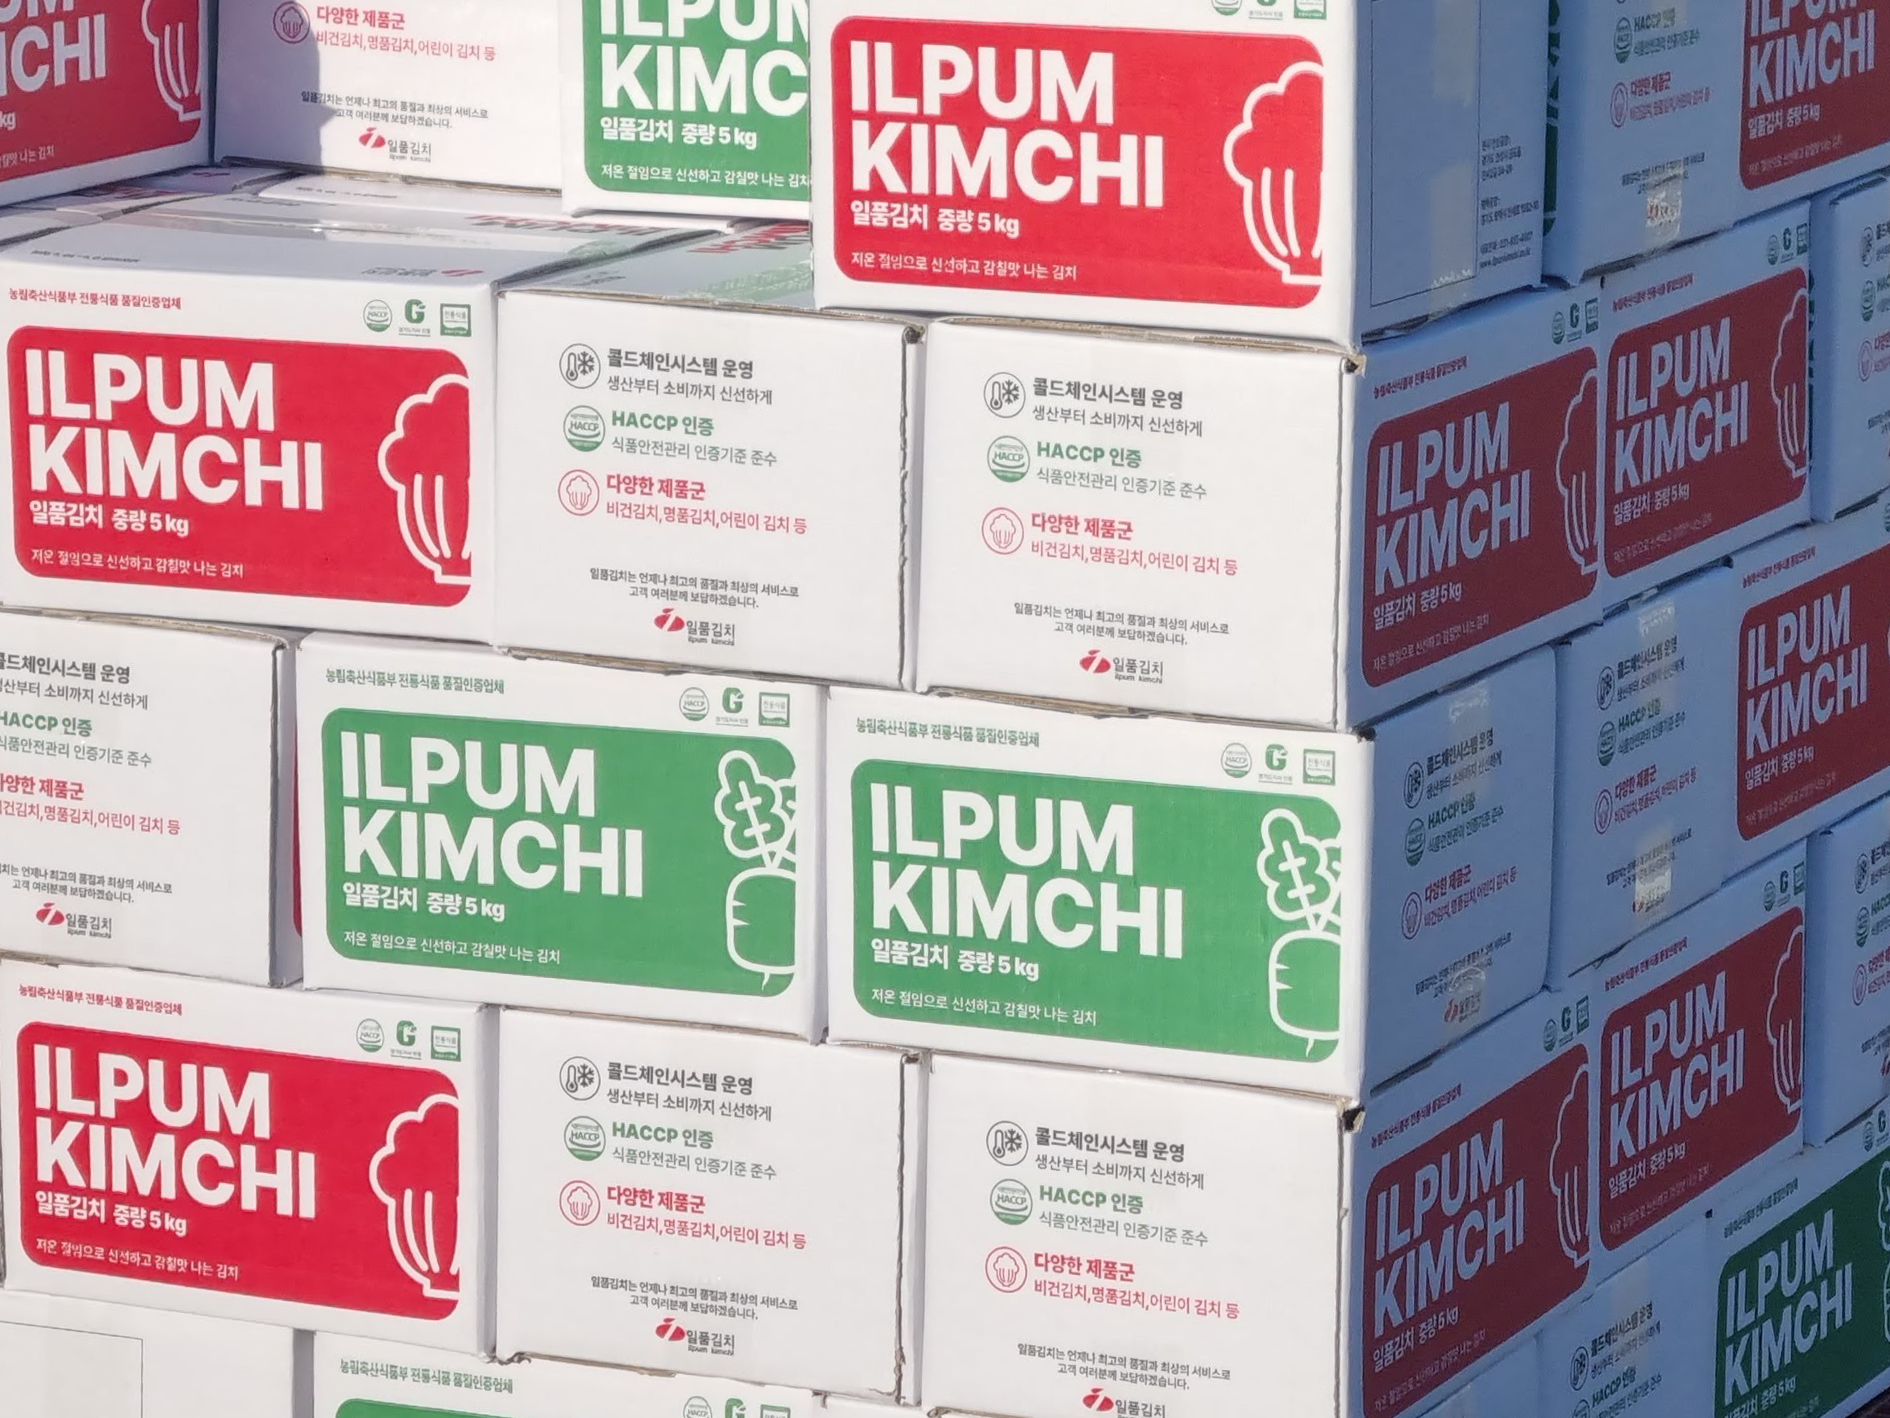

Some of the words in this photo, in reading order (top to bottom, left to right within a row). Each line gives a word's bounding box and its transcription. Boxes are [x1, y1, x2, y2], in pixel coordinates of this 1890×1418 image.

[316, 5, 359, 26] 다양한
[362, 9, 405, 30] 제품군
[1748, 8, 1875, 108] KIMCHI
[601, 44, 808, 117] KIMC
[850, 40, 1114, 125] ILPUM
[852, 119, 1163, 208] KIMCHI
[850, 199, 928, 230] 일품김치
[937, 208, 974, 233] 중량
[931, 256, 980, 274] 신선하고
[983, 259, 1021, 277] 감칠맛
[1023, 263, 1049, 279] 나는
[1052, 264, 1077, 281] 김치
[25, 348, 274, 431] ILPUM
[607, 347, 717, 377] 콜드체인시스템
[721, 359, 753, 379] 운영
[1032, 377, 1146, 407] 콜드체인시스템
[1150, 389, 1183, 410] 운영
[1615, 316, 1730, 421] ILPUM
[611, 410, 678, 431] HACCP
[681, 415, 714, 436] 인증
[1032, 404, 1085, 425] 생산부터
[1089, 411, 1143, 431] 소비까지
[1148, 416, 1202, 437] 신선하게
[1037, 440, 1105, 463] HACCP
[1109, 447, 1142, 468] 인증
[1376, 401, 1509, 517] ILPUM
[1614, 380, 1748, 494] KIMCHI
[29, 423, 323, 511] KIMCHI
[606, 473, 654, 496] 다양한
[657, 478, 706, 501] 제품군
[1036, 467, 1117, 491] 식품안전관리
[1121, 476, 1176, 497] 인증기준
[1179, 482, 1207, 500] 준수
[29, 499, 103, 528] 일품김치
[111, 508, 147, 532] 중량
[1031, 512, 1080, 535] 다양한
[1083, 517, 1133, 541] 제품군
[1374, 468, 1530, 596] KIMCHI
[1192, 556, 1219, 575] 김치
[1223, 558, 1238, 576] 등
[1013, 602, 1062, 618] 일품김치는
[1064, 607, 1093, 621] 언제나
[1095, 610, 1124, 625] 최고의
[1126, 613, 1156, 628] 품질과
[1158, 617, 1187, 631] 최상의
[1189, 620, 1229, 634] 서비스로
[1054, 621, 1073, 634] 고객
[1076, 623, 1115, 638] 여러분께
[1117, 627, 1187, 645] 보답하겠습니다.
[1746, 584, 1850, 690] ILPUM
[1112, 656, 1163, 676] 일품김치
[1746, 642, 1867, 760] KIMCHI
[340, 731, 595, 817] ILPUM
[343, 805, 643, 898] KIMCHI
[870, 782, 1133, 876] ILPUM
[342, 881, 417, 912] 일품김치
[426, 891, 462, 915] 중량
[872, 860, 1183, 959] KIMCHI
[871, 937, 948, 970] 일품김치
[957, 949, 995, 974] 중량
[1610, 970, 1726, 1096] ILPUM
[33, 1043, 270, 1139] ILPUM
[607, 1061, 717, 1092] 콜드체인시스템
[721, 1075, 752, 1095] 운영
[1609, 1027, 1744, 1167] KIMCHI
[36, 1116, 315, 1219] KIMCHI
[612, 1121, 678, 1143] HACCP
[682, 1128, 713, 1149] 인증
[1375, 1118, 1503, 1260] ILPUM
[1374, 1177, 1524, 1338] KIMCHI
[1726, 1209, 1834, 1338] ILPUM
[1724, 1263, 1852, 1406] KIMCHI
